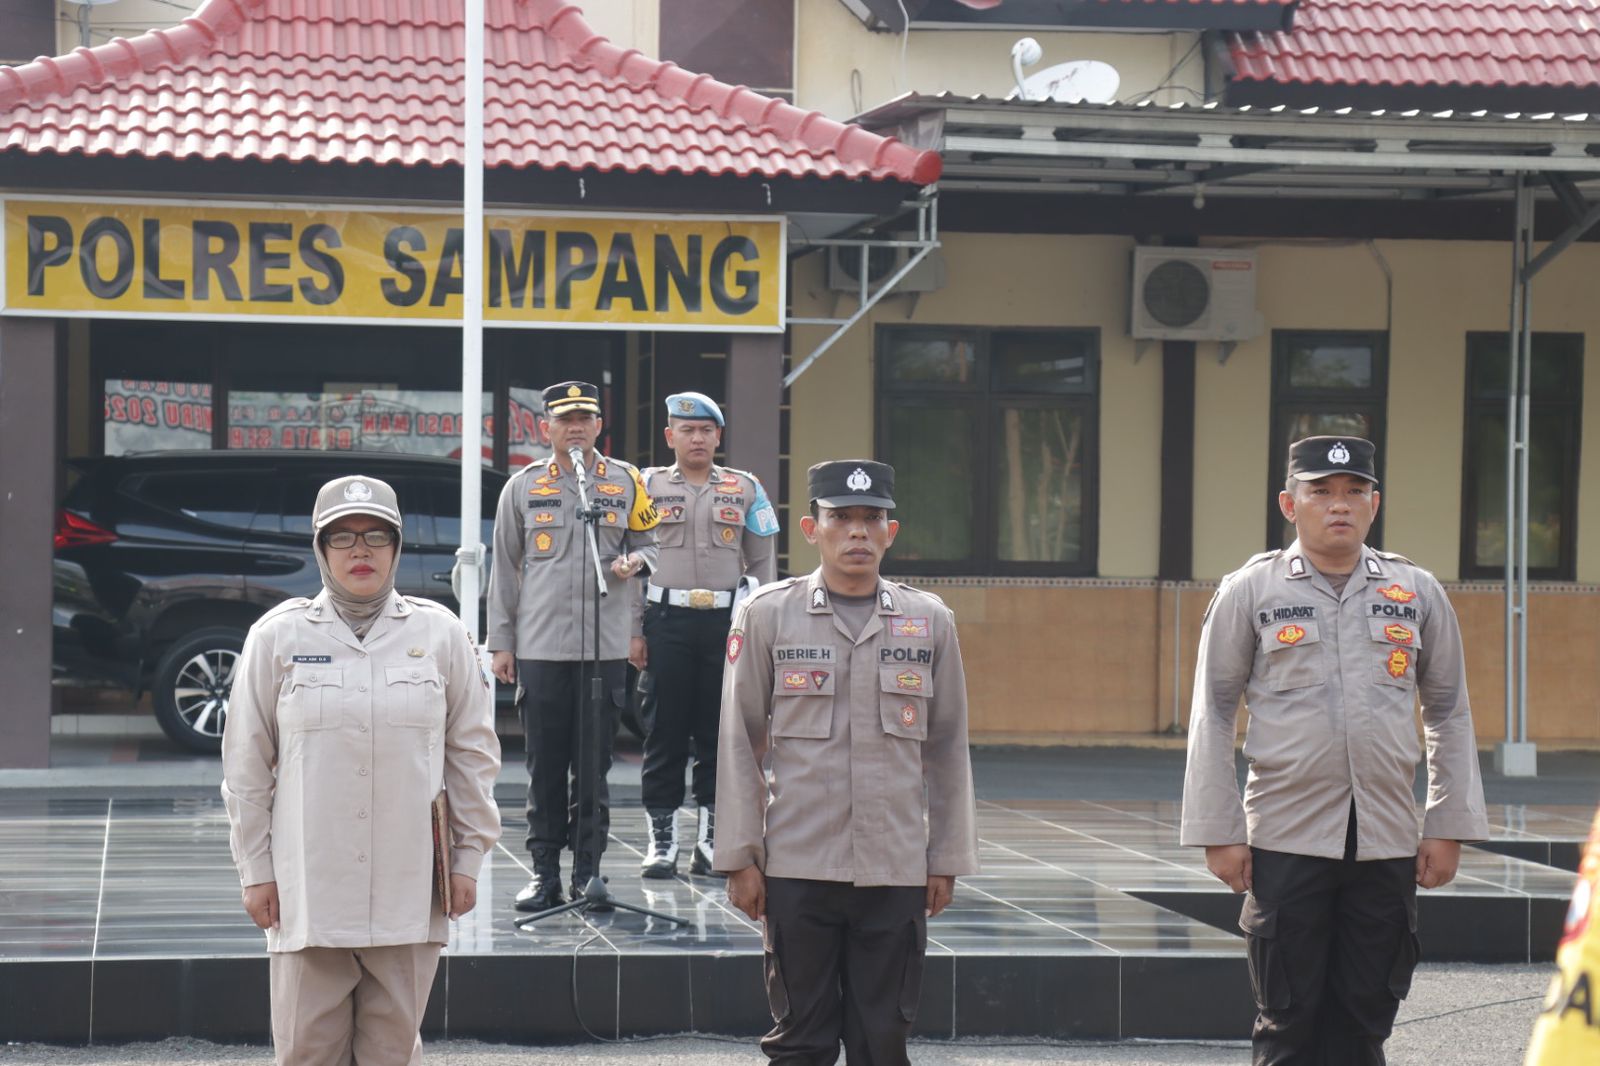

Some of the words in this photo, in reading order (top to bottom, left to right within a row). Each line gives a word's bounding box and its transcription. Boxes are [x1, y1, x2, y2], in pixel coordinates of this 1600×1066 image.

[26, 213, 346, 307] POLRES
[380, 224, 761, 316] SAMPANG
[593, 497, 627, 509] POLRI
[713, 496, 745, 506] POLRI
[1259, 612, 1271, 624] R.
[1273, 606, 1316, 620] HIDAYAT
[1372, 603, 1417, 621] POLRI
[776, 647, 831, 661] DERIE.H
[880, 647, 932, 664] POLRI
